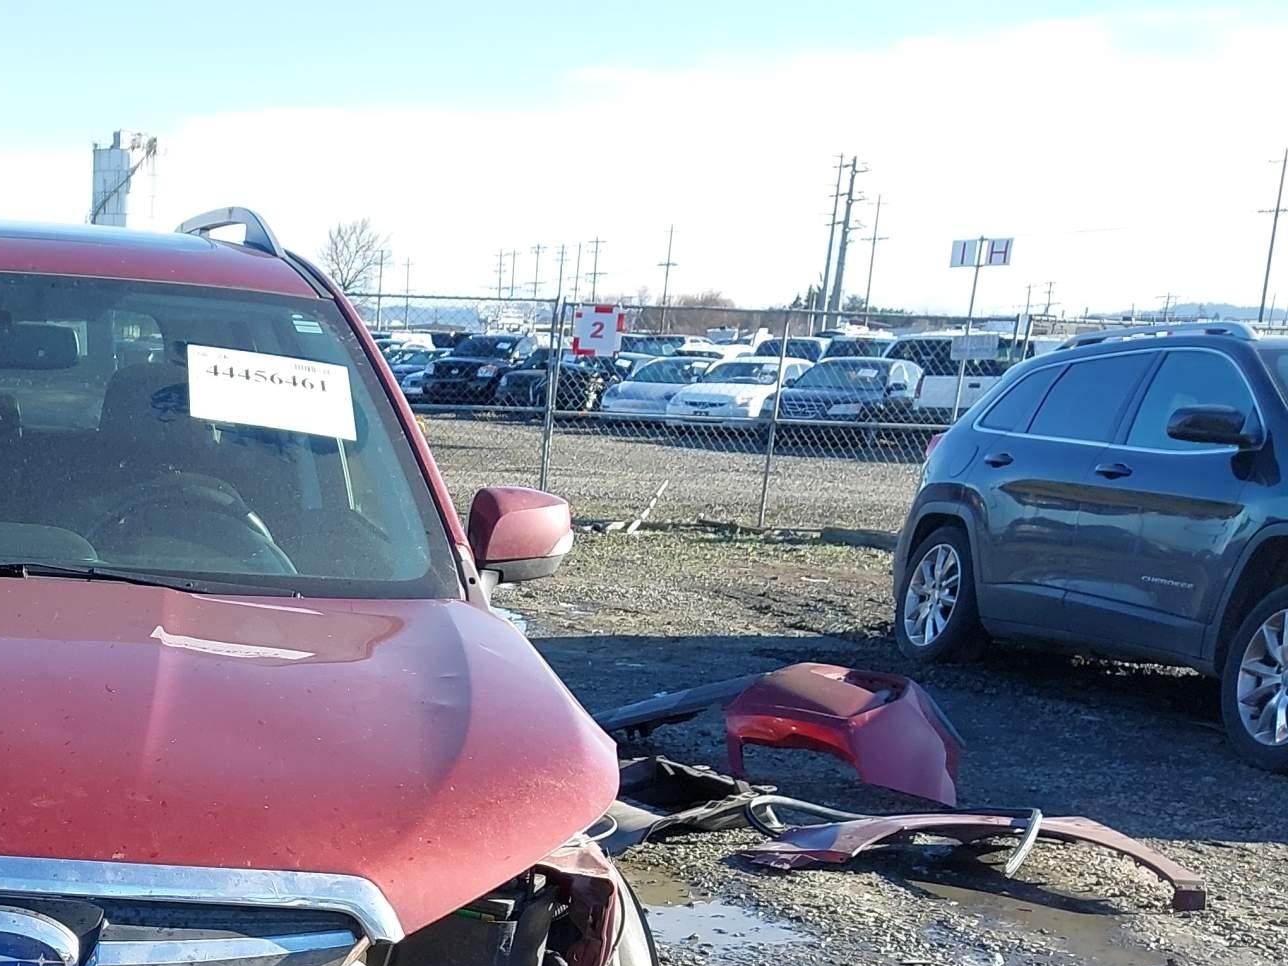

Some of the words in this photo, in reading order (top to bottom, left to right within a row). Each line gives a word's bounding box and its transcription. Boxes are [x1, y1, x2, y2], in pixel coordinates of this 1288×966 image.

[989, 240, 1009, 264] H
[590, 321, 604, 338] 2
[205, 364, 327, 392] 44456461
